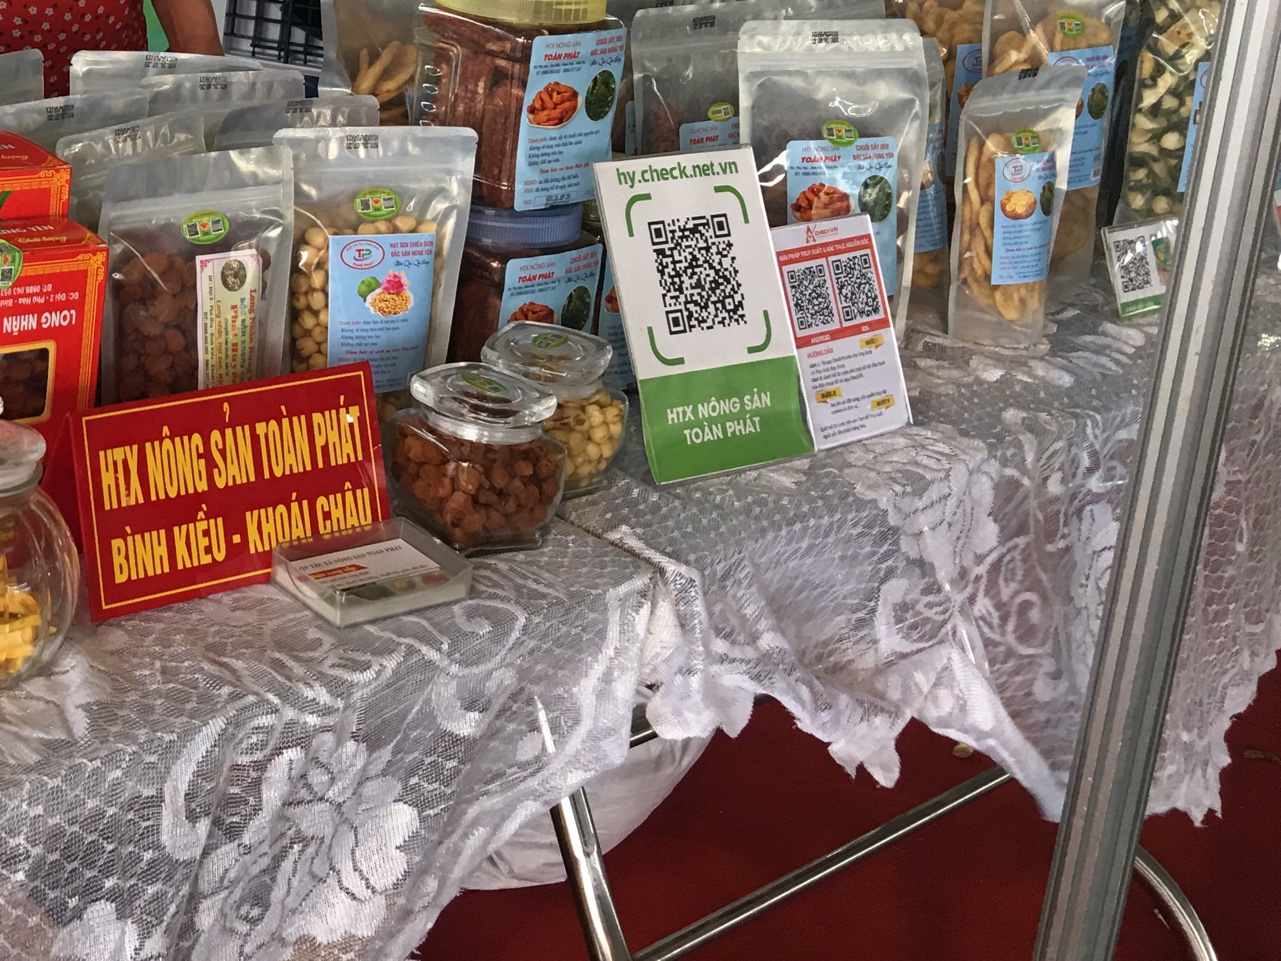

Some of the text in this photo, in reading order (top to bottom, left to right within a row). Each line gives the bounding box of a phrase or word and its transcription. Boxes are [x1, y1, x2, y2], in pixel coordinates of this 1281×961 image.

[544, 50, 580, 61] TOÀN PHÁT
[616, 160, 739, 188] hy.check.net.vn
[518, 272, 554, 283] TOÀN PHÁT
[3, 314, 37, 335] NHÃN
[41, 310, 76, 328] LONG
[667, 388, 771, 424] HTX NÔNG SẢN
[683, 413, 760, 445] TOÀN PHÁT
[98, 394, 363, 511] HTX NÔNG SẢN TOÀN PHÁT
[111, 526, 170, 584] BÌNH
[174, 504, 226, 570] KIỀU
[245, 492, 314, 554] KHOÁI
[316, 481, 372, 539] CHÂU
